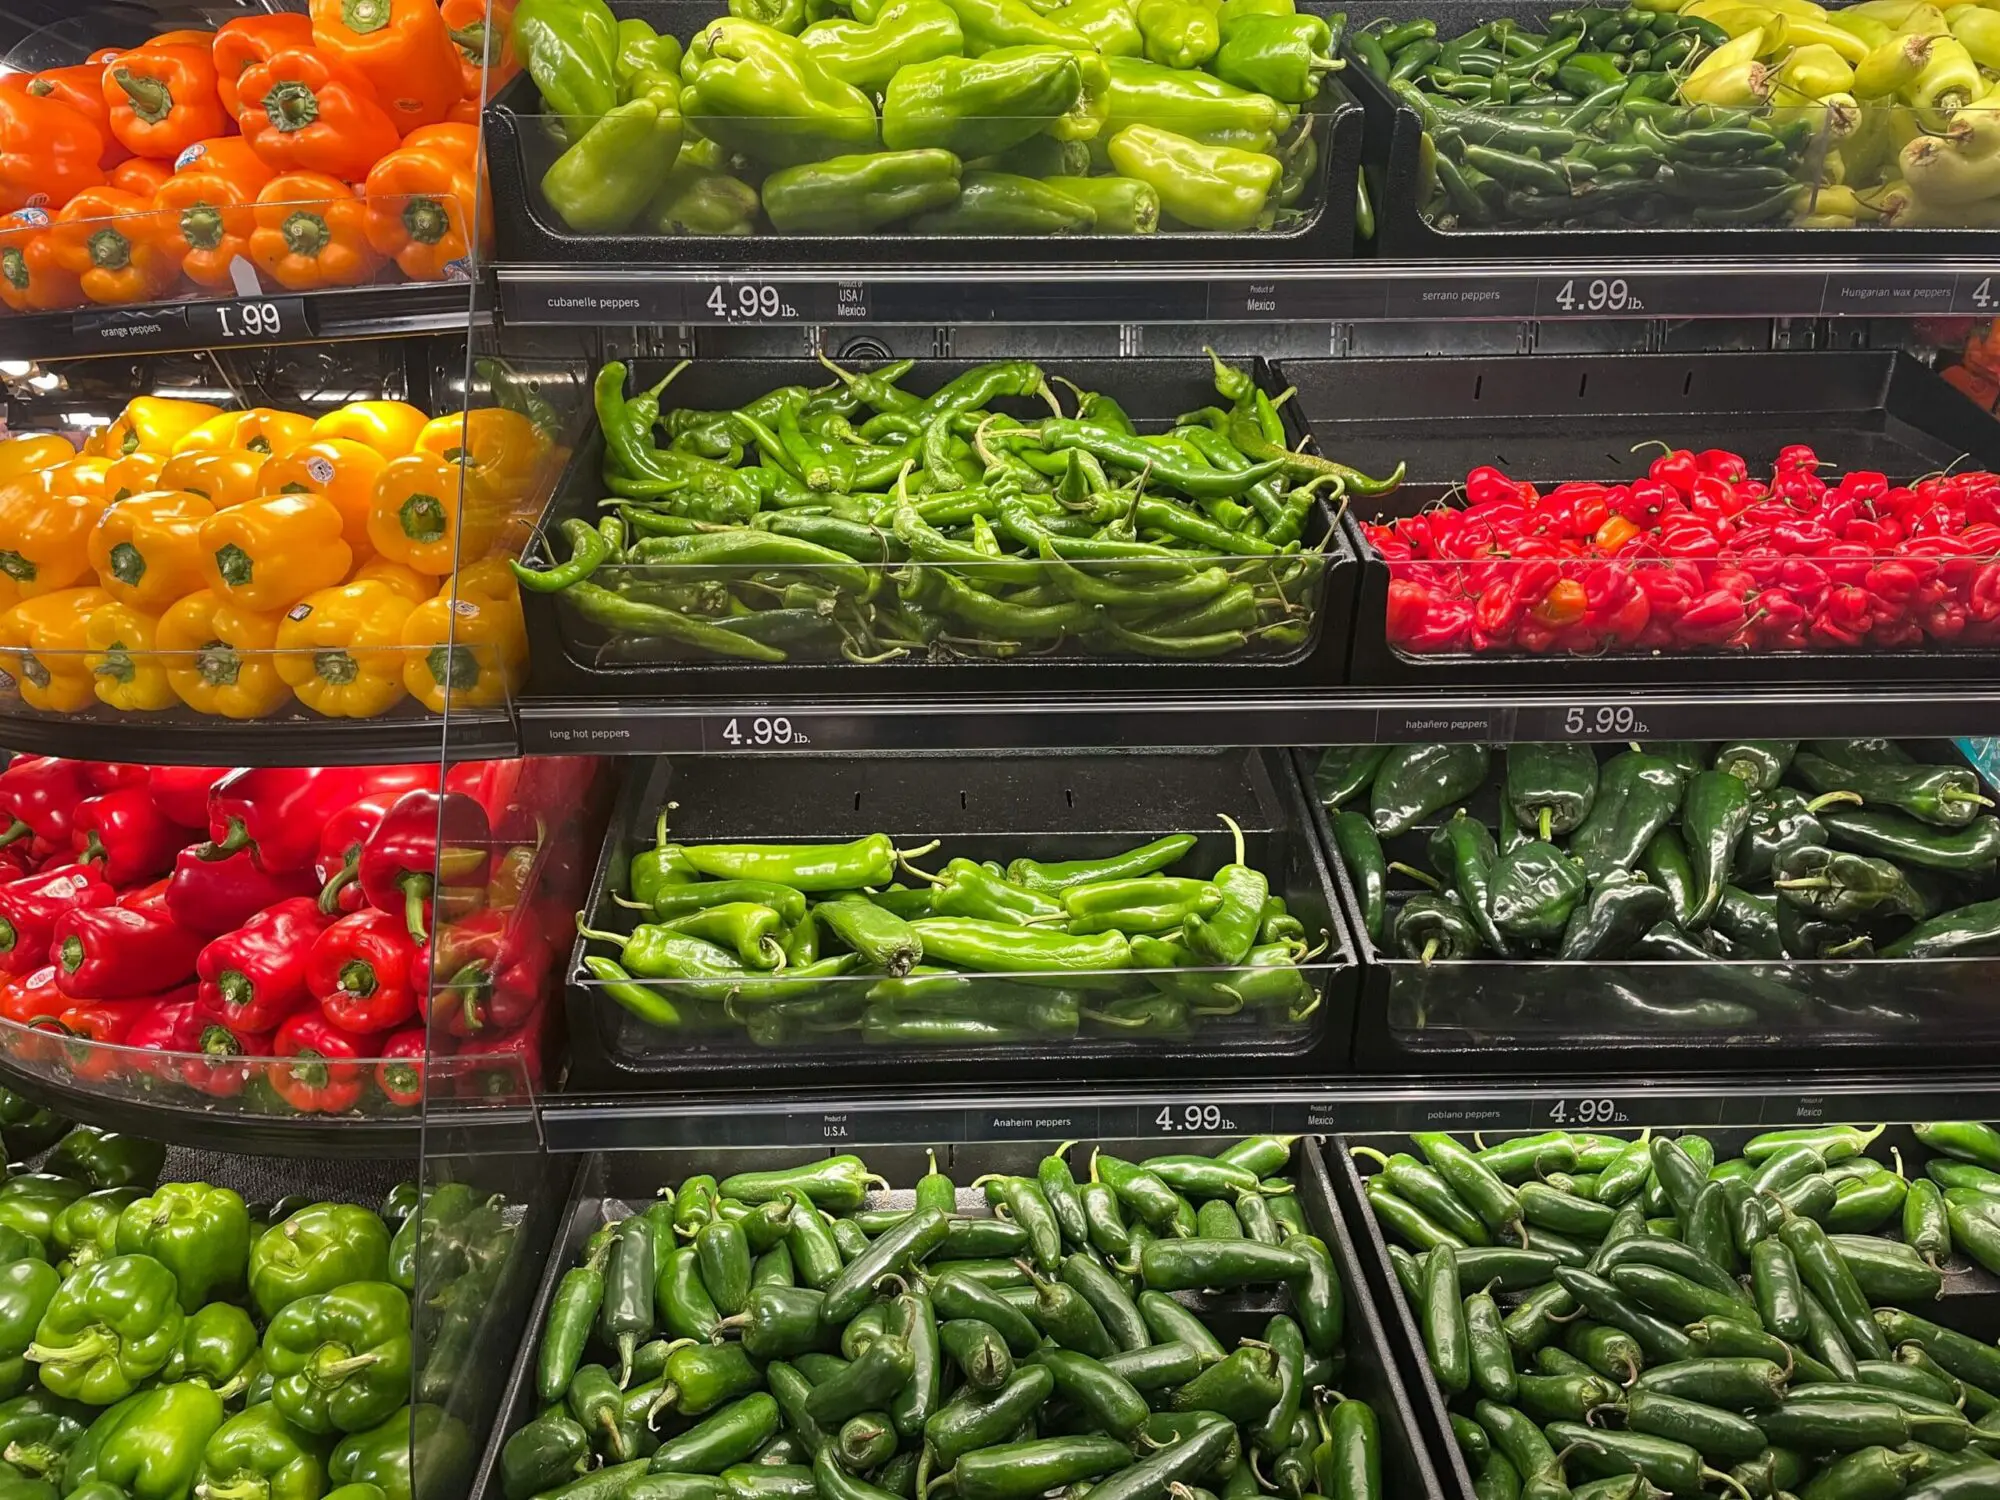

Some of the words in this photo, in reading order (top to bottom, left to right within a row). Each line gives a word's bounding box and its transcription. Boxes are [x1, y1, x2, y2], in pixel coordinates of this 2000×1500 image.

[1249, 285, 1269, 294] Product
[1269, 284, 1275, 293] of
[1555, 279, 1628, 311] 4.99
[1628, 296, 1645, 310] lb.
[1841, 287, 1890, 299] Hungarian
[1893, 289, 1911, 297] wax
[1913, 288, 1952, 299] peppers
[706, 285, 780, 317] 4.99
[781, 304, 800, 317] lb.
[840, 289, 858, 302] USA
[1422, 291, 1459, 301] serrano
[1461, 290, 1501, 302] peppers
[547, 297, 597, 308] cubanelle
[600, 298, 640, 309] peppers
[1246, 298, 1276, 311] Mexico
[837, 303, 867, 317] Mexico
[216, 303, 282, 338] 1.99
[101, 326, 128, 338] orange
[129, 323, 162, 337] peppers
[1405, 719, 1449, 730] habañero
[1451, 719, 1489, 731] peppers
[1564, 706, 1634, 734] 5.99
[1633, 722, 1651, 734] lb.
[549, 729, 571, 740] long
[573, 729, 589, 739] hot
[591, 730, 631, 741] peppers
[722, 717, 793, 746] 4.99
[793, 732, 812, 744] lb.
[1427, 1110, 1463, 1121] poblano
[1465, 1110, 1501, 1121] peppers
[1549, 1099, 1615, 1123] 4.99
[1614, 1111, 1631, 1123] lb.
[1796, 1107, 1823, 1117] Mexico
[824, 1114, 841, 1122] Product
[993, 1117, 1033, 1127] Anaheim
[1035, 1118, 1072, 1129] peppers
[1155, 1105, 1222, 1131] 4.99
[1222, 1117, 1238, 1130] lb.
[1307, 1114, 1334, 1126] Mexico
[823, 1126, 849, 1137] U.S.A.
